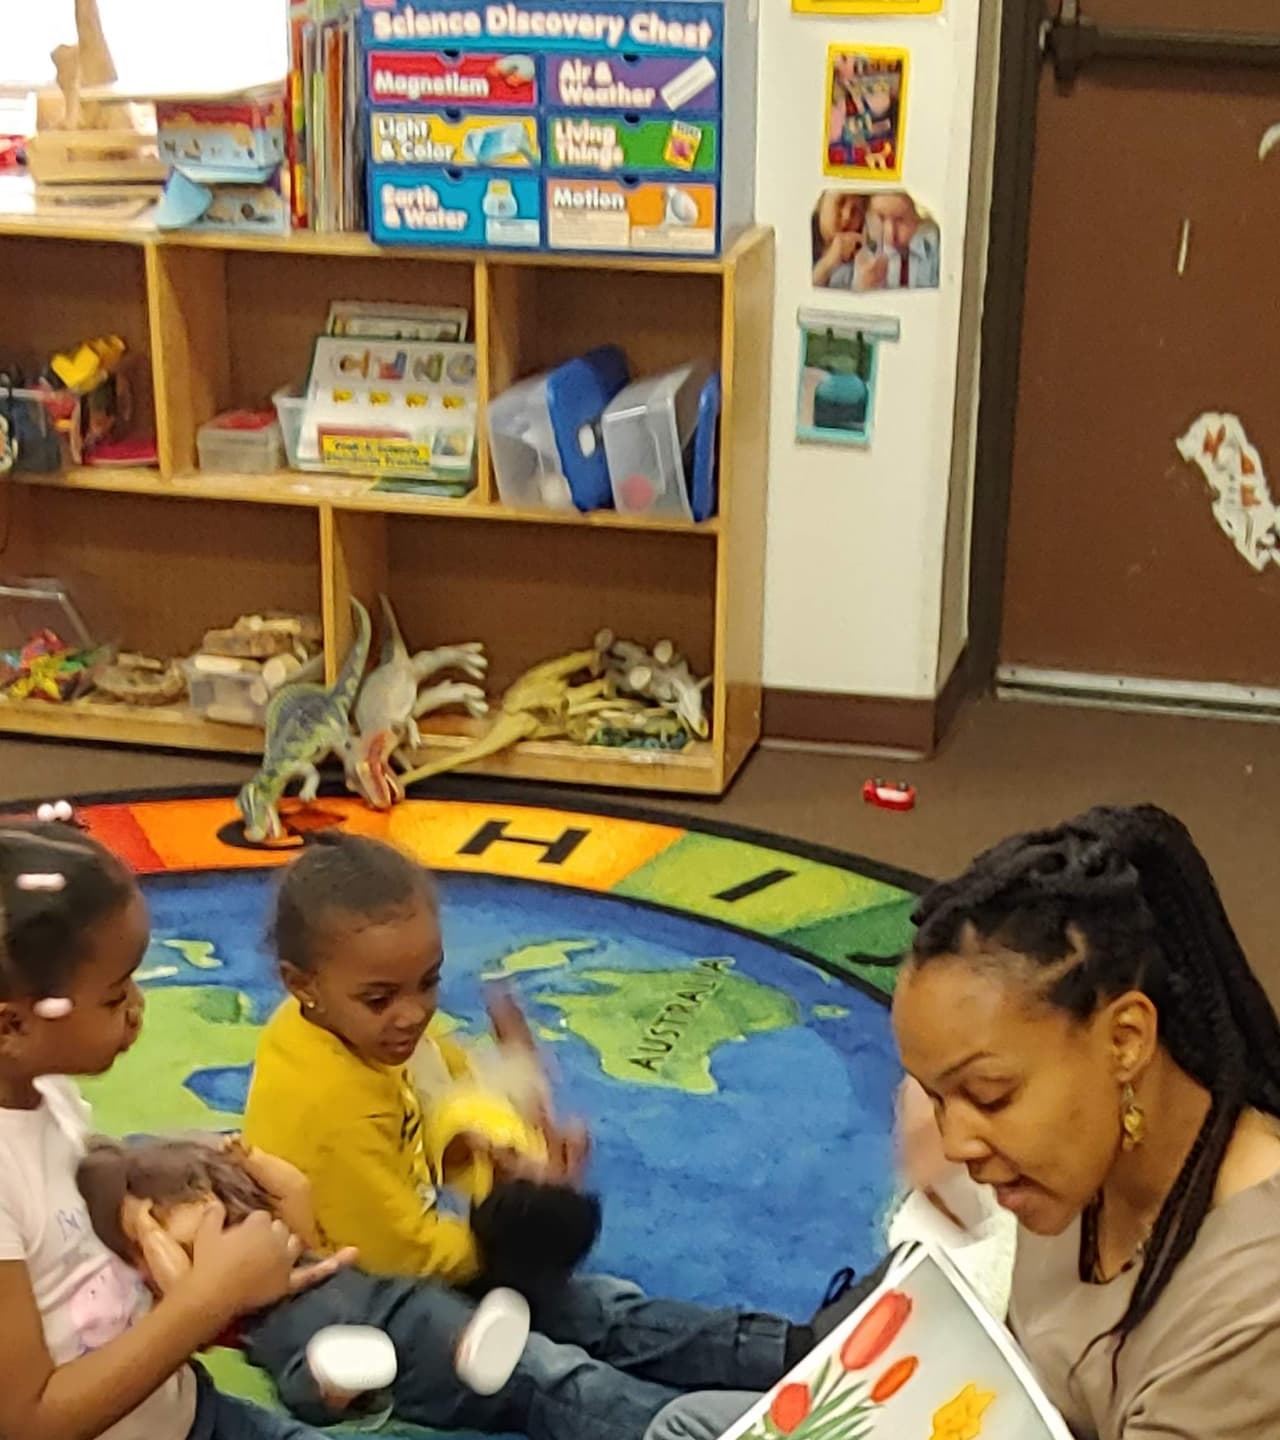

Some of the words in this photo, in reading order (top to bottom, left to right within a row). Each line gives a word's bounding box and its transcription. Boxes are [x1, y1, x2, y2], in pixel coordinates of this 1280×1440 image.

[373, 7, 481, 41] Science
[485, 5, 625, 48] Discovery
[628, 12, 712, 49] Chest
[559, 58, 592, 85] Air
[595, 61, 613, 84] &
[373, 70, 489, 101] Magnetism
[560, 81, 656, 108] Weather
[377, 117, 432, 141] Light
[554, 119, 617, 146] Living
[379, 140, 397, 160] &
[400, 138, 455, 162] Color
[555, 142, 624, 171] Things
[381, 184, 439, 210] Earth
[552, 187, 625, 211] Motion
[404, 206, 468, 231] Water
[456, 818, 592, 865] H
[712, 867, 798, 903] I
[629, 960, 720, 1073] AUSTRALIA
